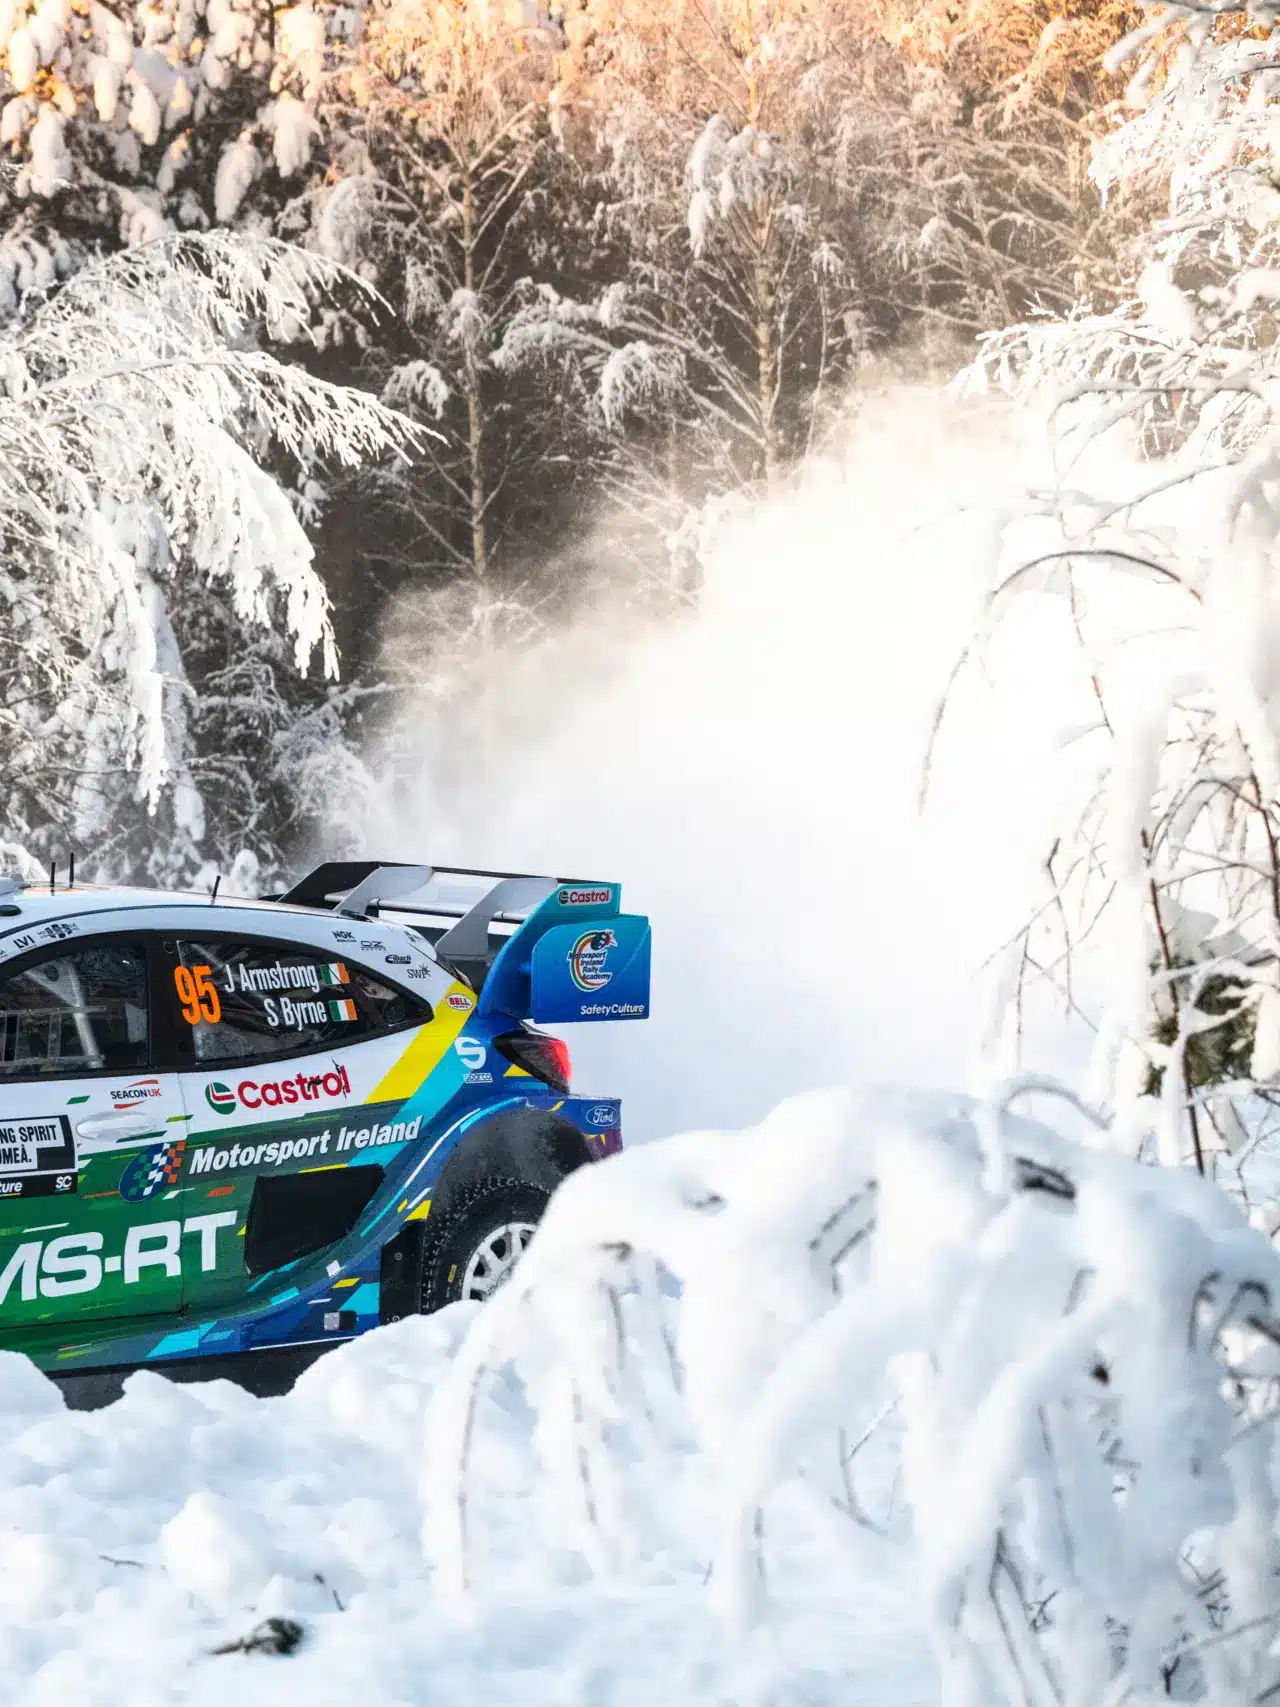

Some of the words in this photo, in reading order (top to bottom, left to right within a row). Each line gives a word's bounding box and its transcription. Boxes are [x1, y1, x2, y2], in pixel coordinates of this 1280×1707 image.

[570, 889, 609, 903] Castrol
[332, 930, 355, 939] NGK
[385, 954, 412, 964] Eibach
[174, 965, 221, 1025] 95
[224, 964, 235, 993] J
[239, 960, 320, 993] Armstrong
[449, 997, 470, 1006] BELL
[264, 998, 279, 1027] S
[280, 997, 328, 1031] Byrne
[580, 1003, 645, 1016] SafetyCulture
[237, 1065, 351, 1109] Castrol
[593, 1107, 614, 1124] Ford
[19, 1124, 57, 1142] SPIRIT
[188, 1127, 332, 1175] Motorsport
[336, 1114, 423, 1151] Ireland
[55, 1175, 73, 1189] SC
